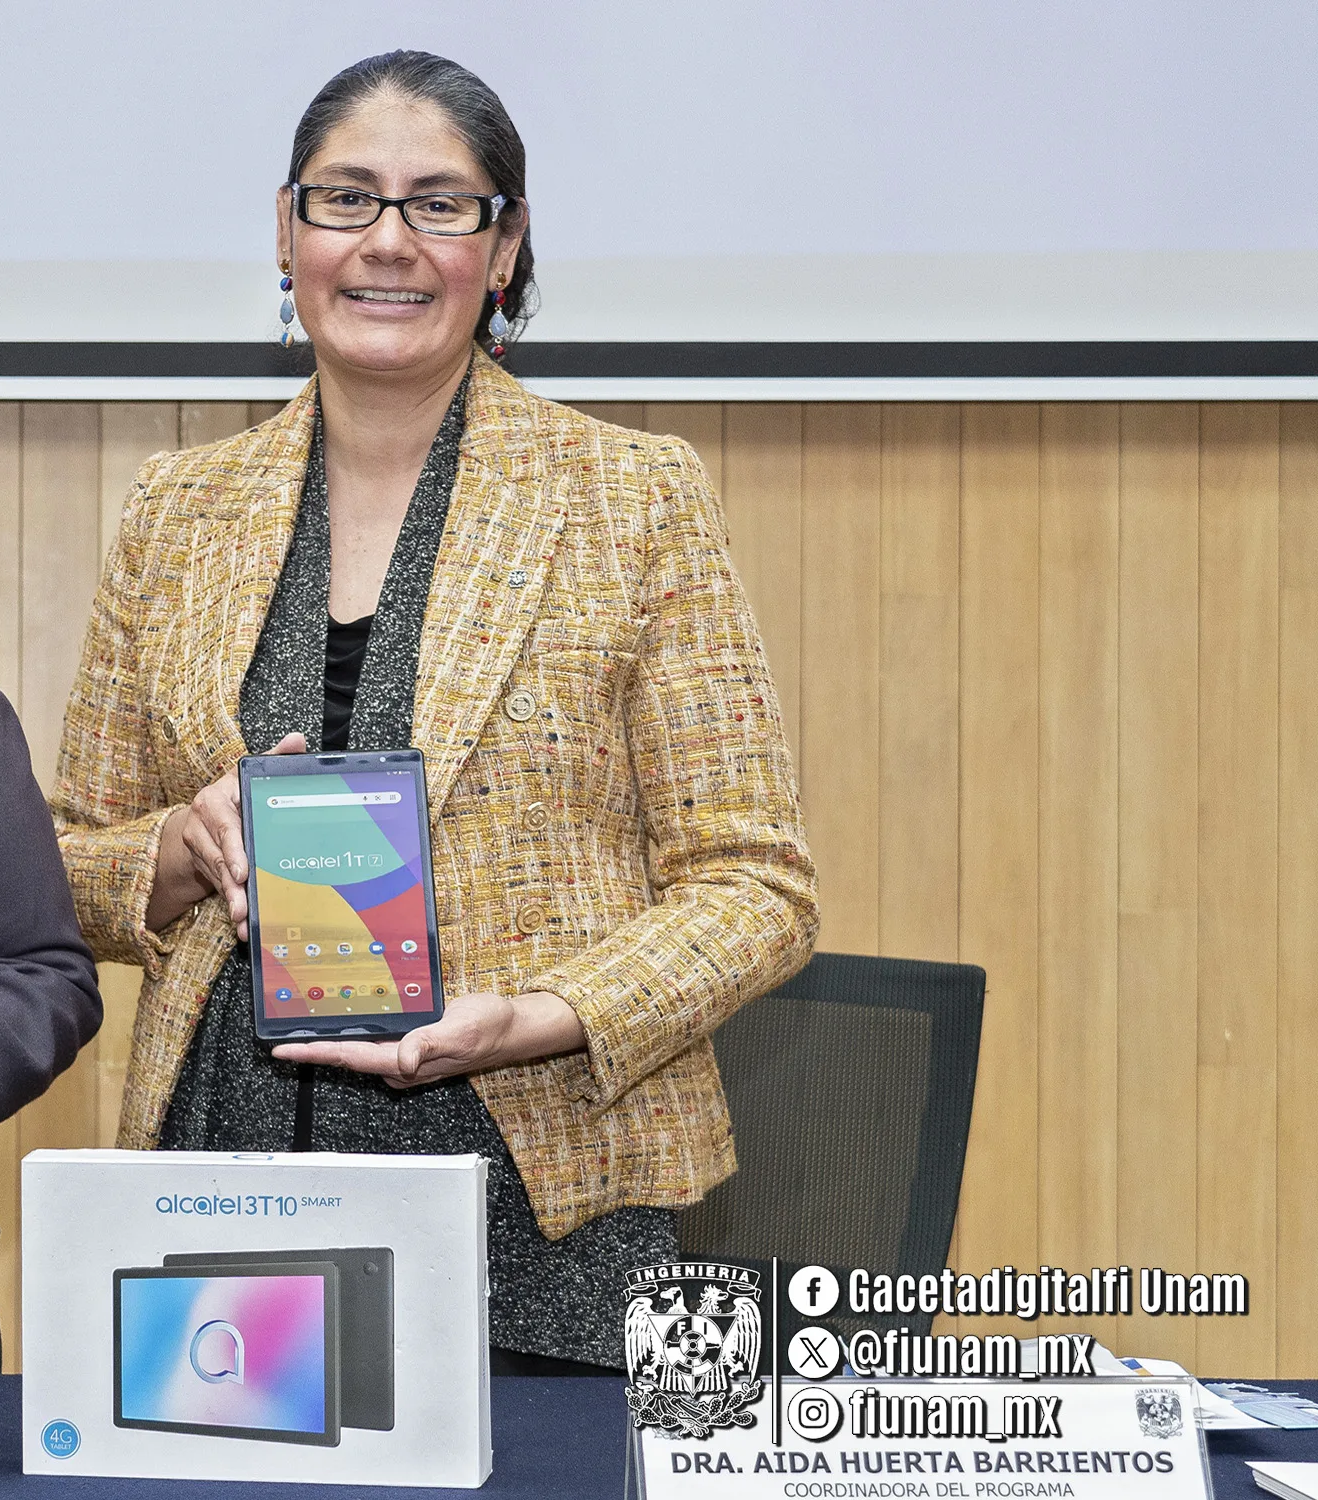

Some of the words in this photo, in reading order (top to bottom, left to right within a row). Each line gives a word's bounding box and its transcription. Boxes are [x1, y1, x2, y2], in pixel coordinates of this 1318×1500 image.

[279, 855, 340, 869] alcatel
[371, 856, 379, 865] 7
[301, 1197, 342, 1207] SMART
[50, 1429, 72, 1443] 4G
[670, 1451, 743, 1473] DRA.
[753, 1451, 832, 1473] AIDA
[840, 1451, 965, 1473] HUERTA
[973, 1450, 1174, 1473] BARRIENTOS
[783, 1482, 930, 1498] COORDINADORA
[936, 1482, 969, 1497] DEL
[975, 1482, 1074, 1497] PROGRAMA
